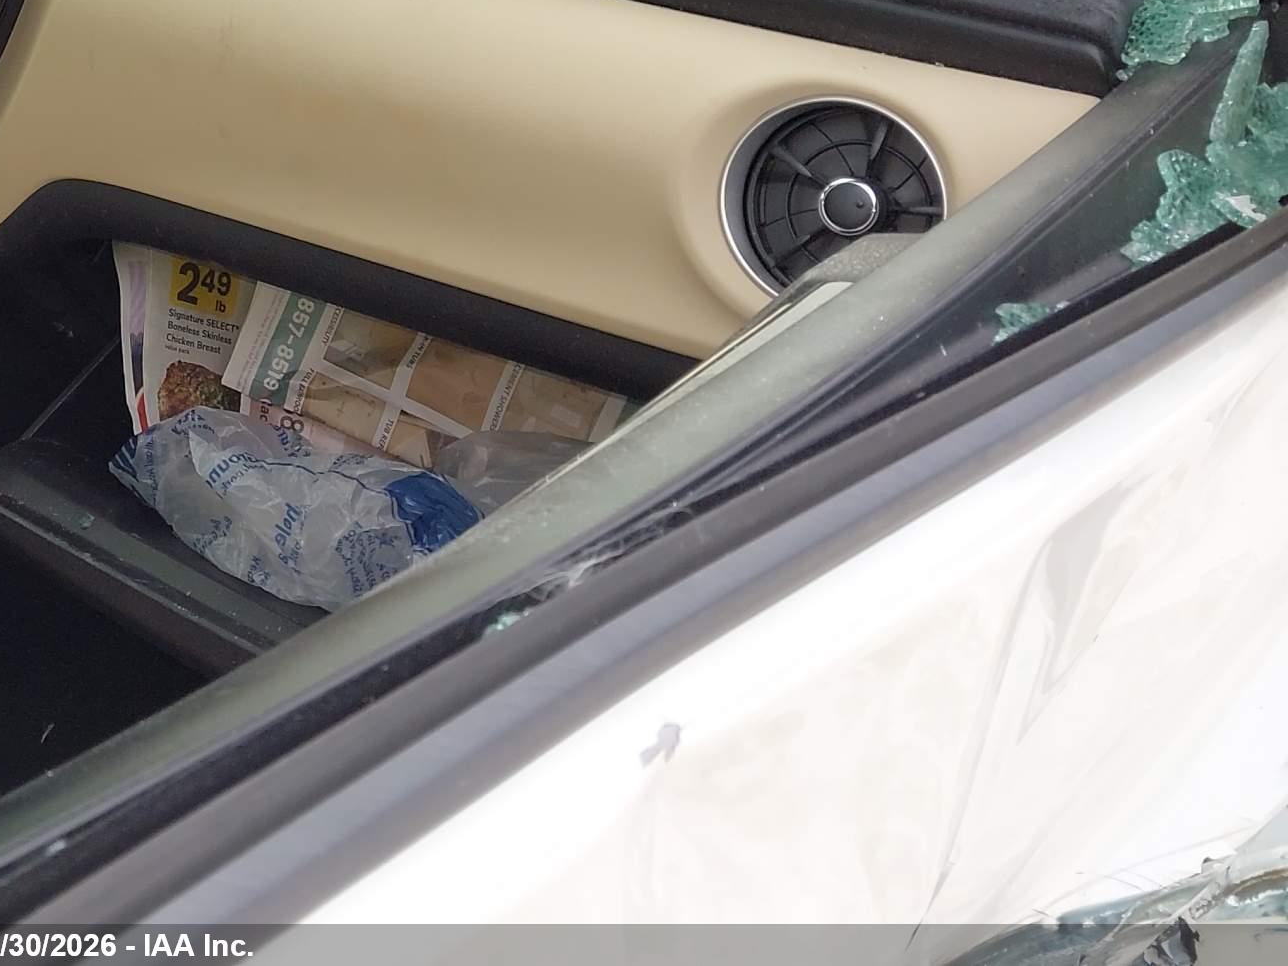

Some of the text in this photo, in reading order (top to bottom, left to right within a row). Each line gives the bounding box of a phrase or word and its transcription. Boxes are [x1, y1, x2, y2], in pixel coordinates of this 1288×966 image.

[168, 308, 204, 325] Signature
[215, 300, 226, 313] lb
[166, 333, 221, 355] Chicken Breast
[167, 321, 232, 345] Boneless Skinless
[263, 298, 314, 390] 857-8519
